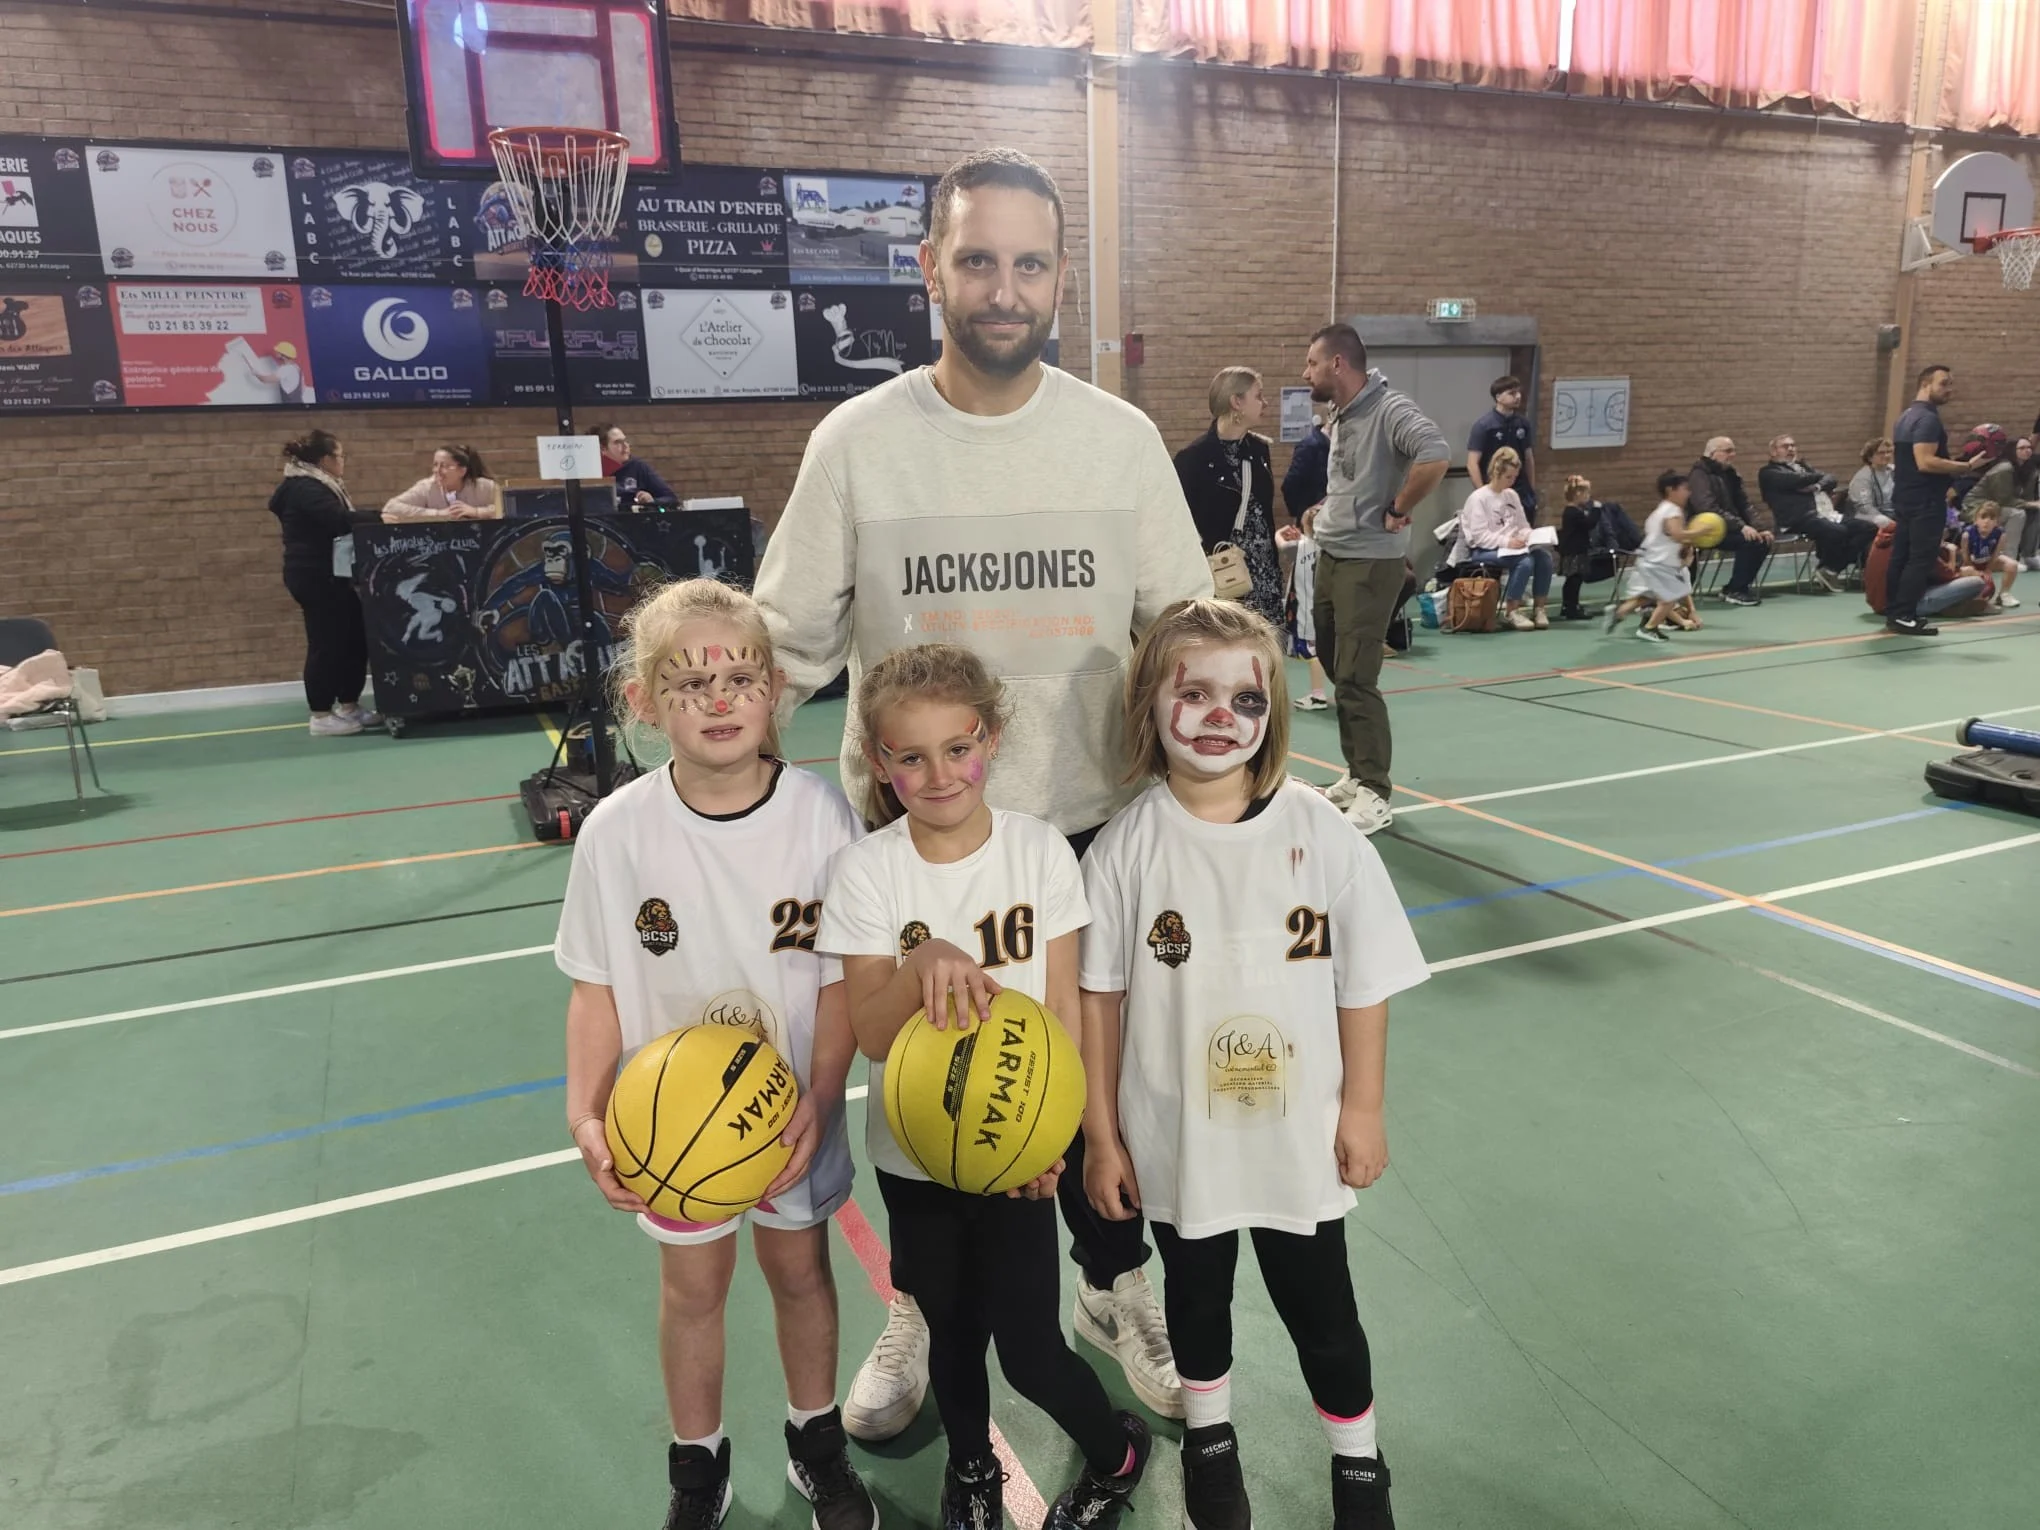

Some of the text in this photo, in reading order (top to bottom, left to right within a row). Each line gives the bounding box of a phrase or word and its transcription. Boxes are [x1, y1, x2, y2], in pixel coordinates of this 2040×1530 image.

[172, 207, 216, 219] CHEZ
[636, 199, 784, 216] AU TRAIN D'ENFER
[173, 222, 218, 233] NOUS
[637, 219, 709, 233] BRASSERIE
[717, 221, 783, 235] GRILLADE
[687, 239, 738, 256] PIZZA
[120, 290, 247, 299] Ets MILLE PEINTURE
[148, 320, 230, 331] 03 21 83 39 22
[700, 321, 743, 333] L'Atelier
[704, 333, 752, 346] Chocolat
[354, 366, 448, 381] GALLOO
[902, 549, 1096, 596] JACK&JONES
[516, 644, 540, 657] LES
[642, 929, 677, 944] BCSF
[973, 903, 1034, 970] 16
[1285, 904, 1333, 962] 21
[1156, 942, 1190, 956] BCSF
[973, 1018, 1026, 1152] TARMAK
[1015, 1050, 1036, 1123] RESIST 100
[1201, 1438, 1233, 1455] SKECHERS
[1341, 1469, 1377, 1479] SKECHERS
